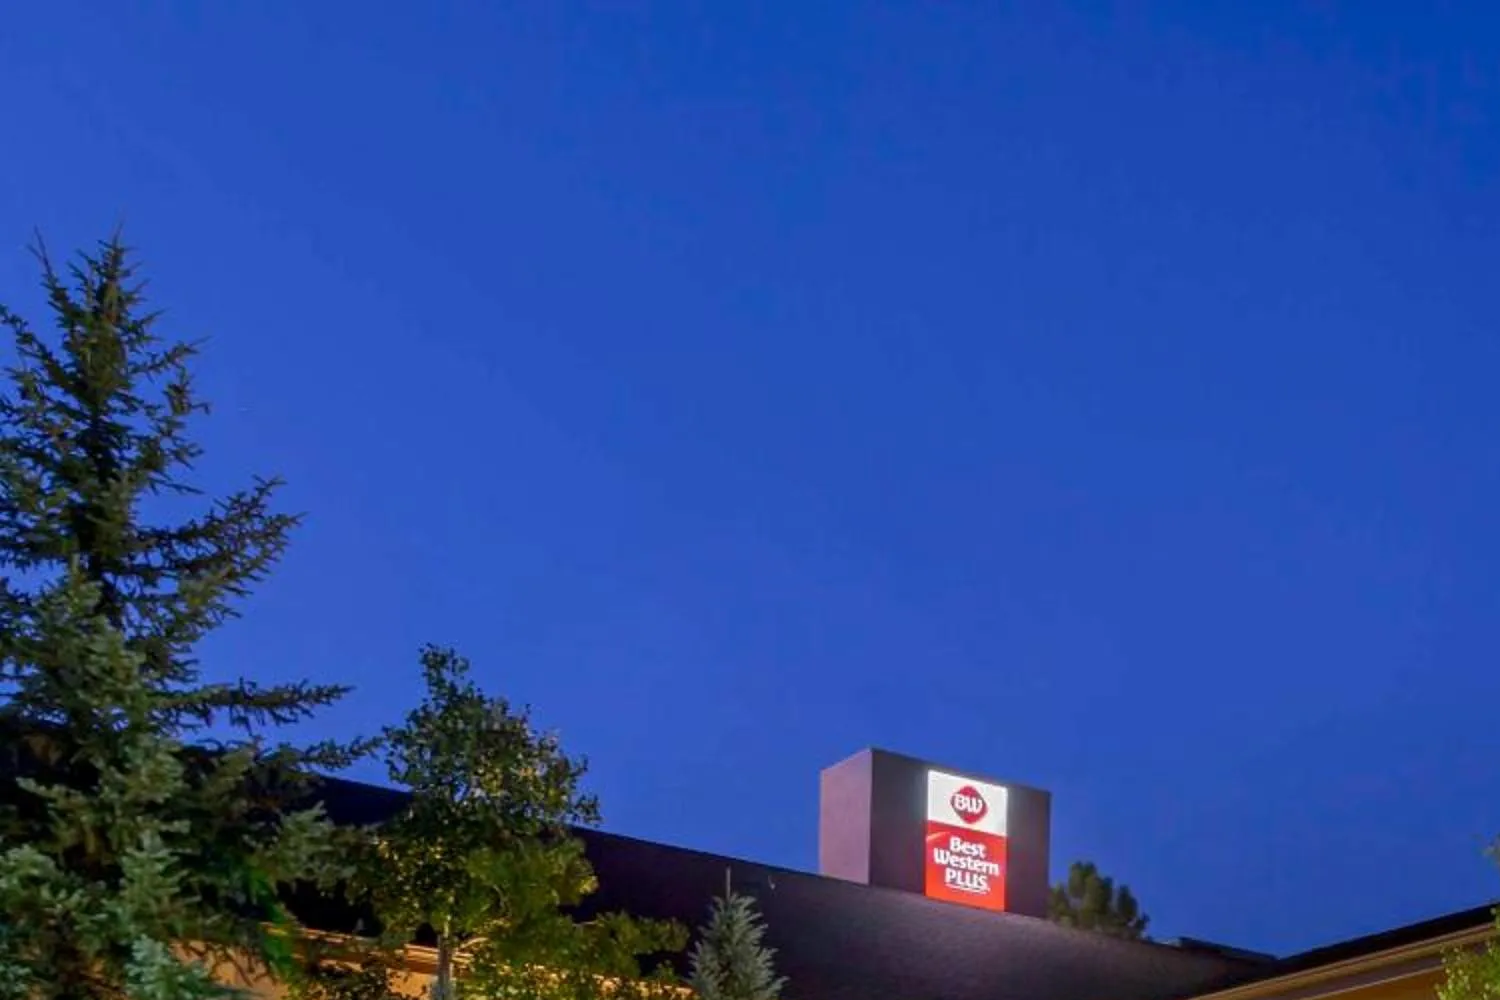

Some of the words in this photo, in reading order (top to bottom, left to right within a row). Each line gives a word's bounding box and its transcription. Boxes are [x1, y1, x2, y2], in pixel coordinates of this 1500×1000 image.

[953, 793, 983, 814] BW
[950, 835, 986, 859] Best
[933, 847, 999, 877] Western
[945, 867, 989, 891] PLUS
